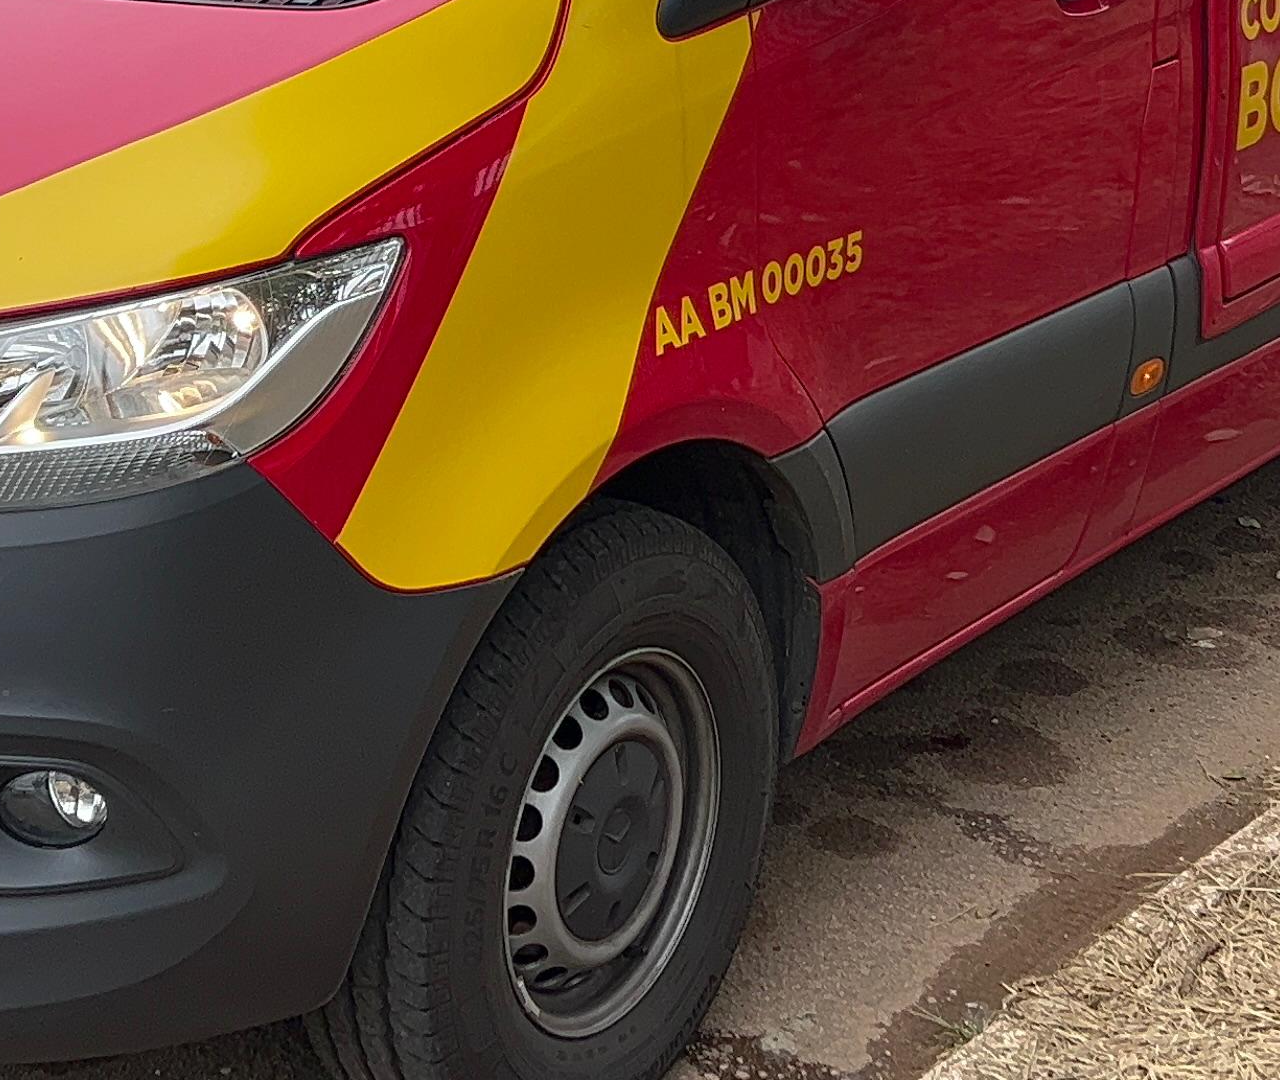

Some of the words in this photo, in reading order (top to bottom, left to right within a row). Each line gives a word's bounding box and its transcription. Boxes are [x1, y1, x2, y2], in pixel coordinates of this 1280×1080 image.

[655, 295, 707, 357] AA
[707, 270, 757, 331] BM
[761, 230, 863, 304] 00035
